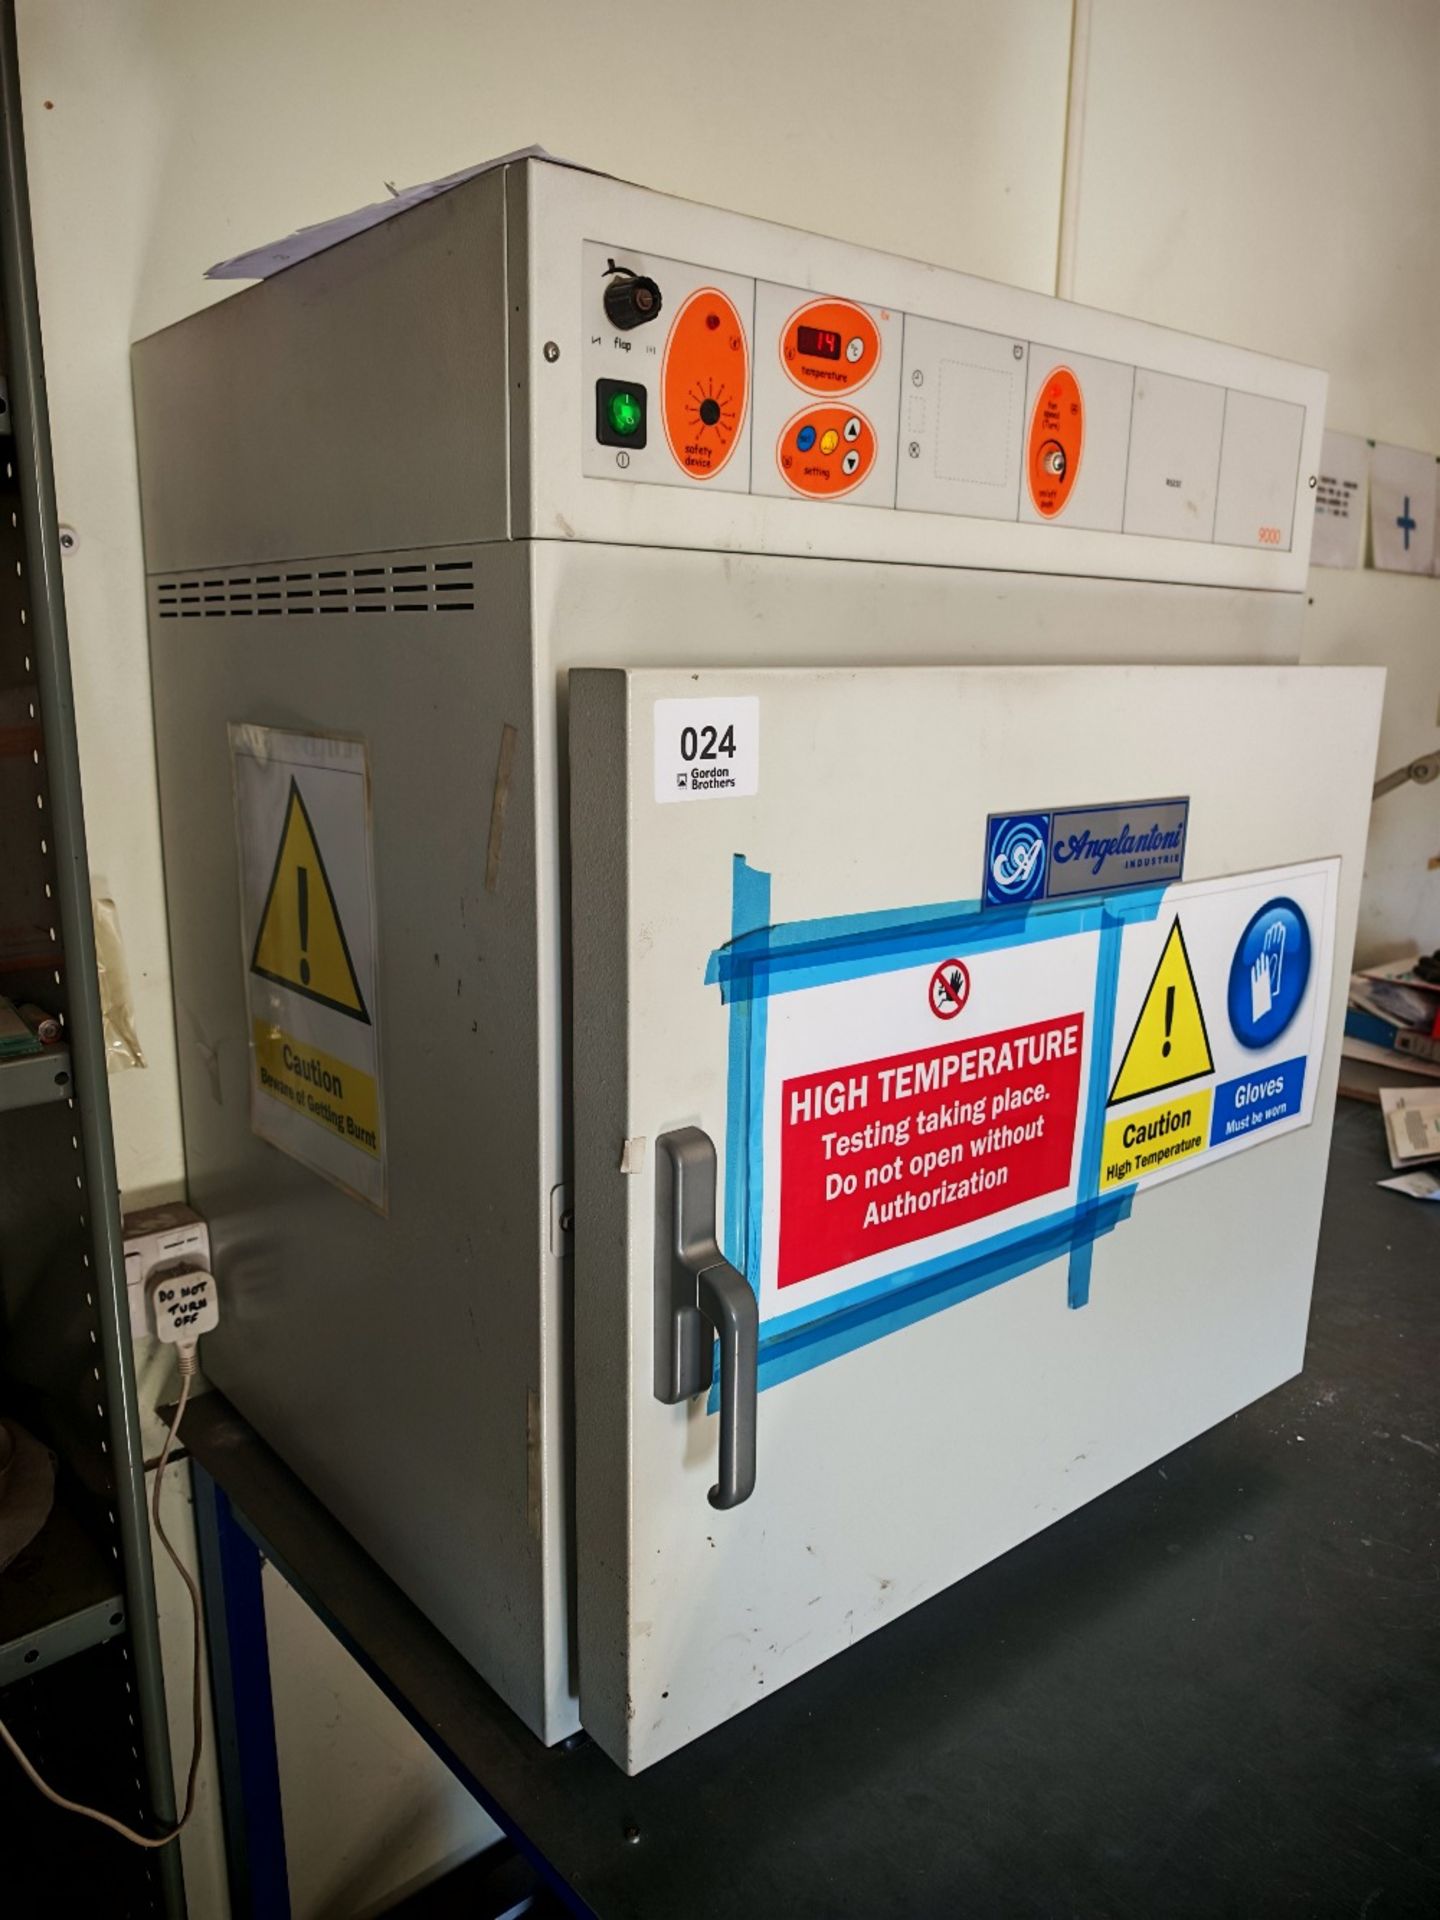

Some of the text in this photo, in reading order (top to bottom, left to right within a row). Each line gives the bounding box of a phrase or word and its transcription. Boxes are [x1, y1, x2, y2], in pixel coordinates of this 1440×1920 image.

[614, 336, 632, 353] flap
[816, 331, 835, 353] 14
[801, 366, 848, 383] temperature
[684, 444, 712, 459] safety
[685, 456, 711, 468] device
[803, 467, 830, 481] setting
[1258, 527, 1281, 545] 9000
[680, 724, 737, 761] 024
[691, 767, 729, 779] Gordon
[691, 777, 736, 790] Brothers
[1053, 821, 1184, 876] Angelantoni
[1124, 854, 1180, 869] INDUSTRIE
[282, 1043, 343, 1099] Caution
[789, 1024, 1079, 1126] HIGH TEMPERATURE
[1234, 1076, 1284, 1109] Gloves
[260, 1066, 377, 1150] Beware of Getting Burnt
[1225, 1102, 1287, 1136] Must be worn
[821, 1082, 1051, 1161] Testing taking place.
[1122, 1109, 1192, 1149] Caution
[825, 1114, 1045, 1201] Do not open without
[1106, 1135, 1202, 1181] High Temperature
[863, 1165, 1009, 1229] Authorization
[158, 1281, 208, 1303] DO NOT
[167, 1298, 208, 1315] TURN
[174, 1312, 199, 1328] OFF
